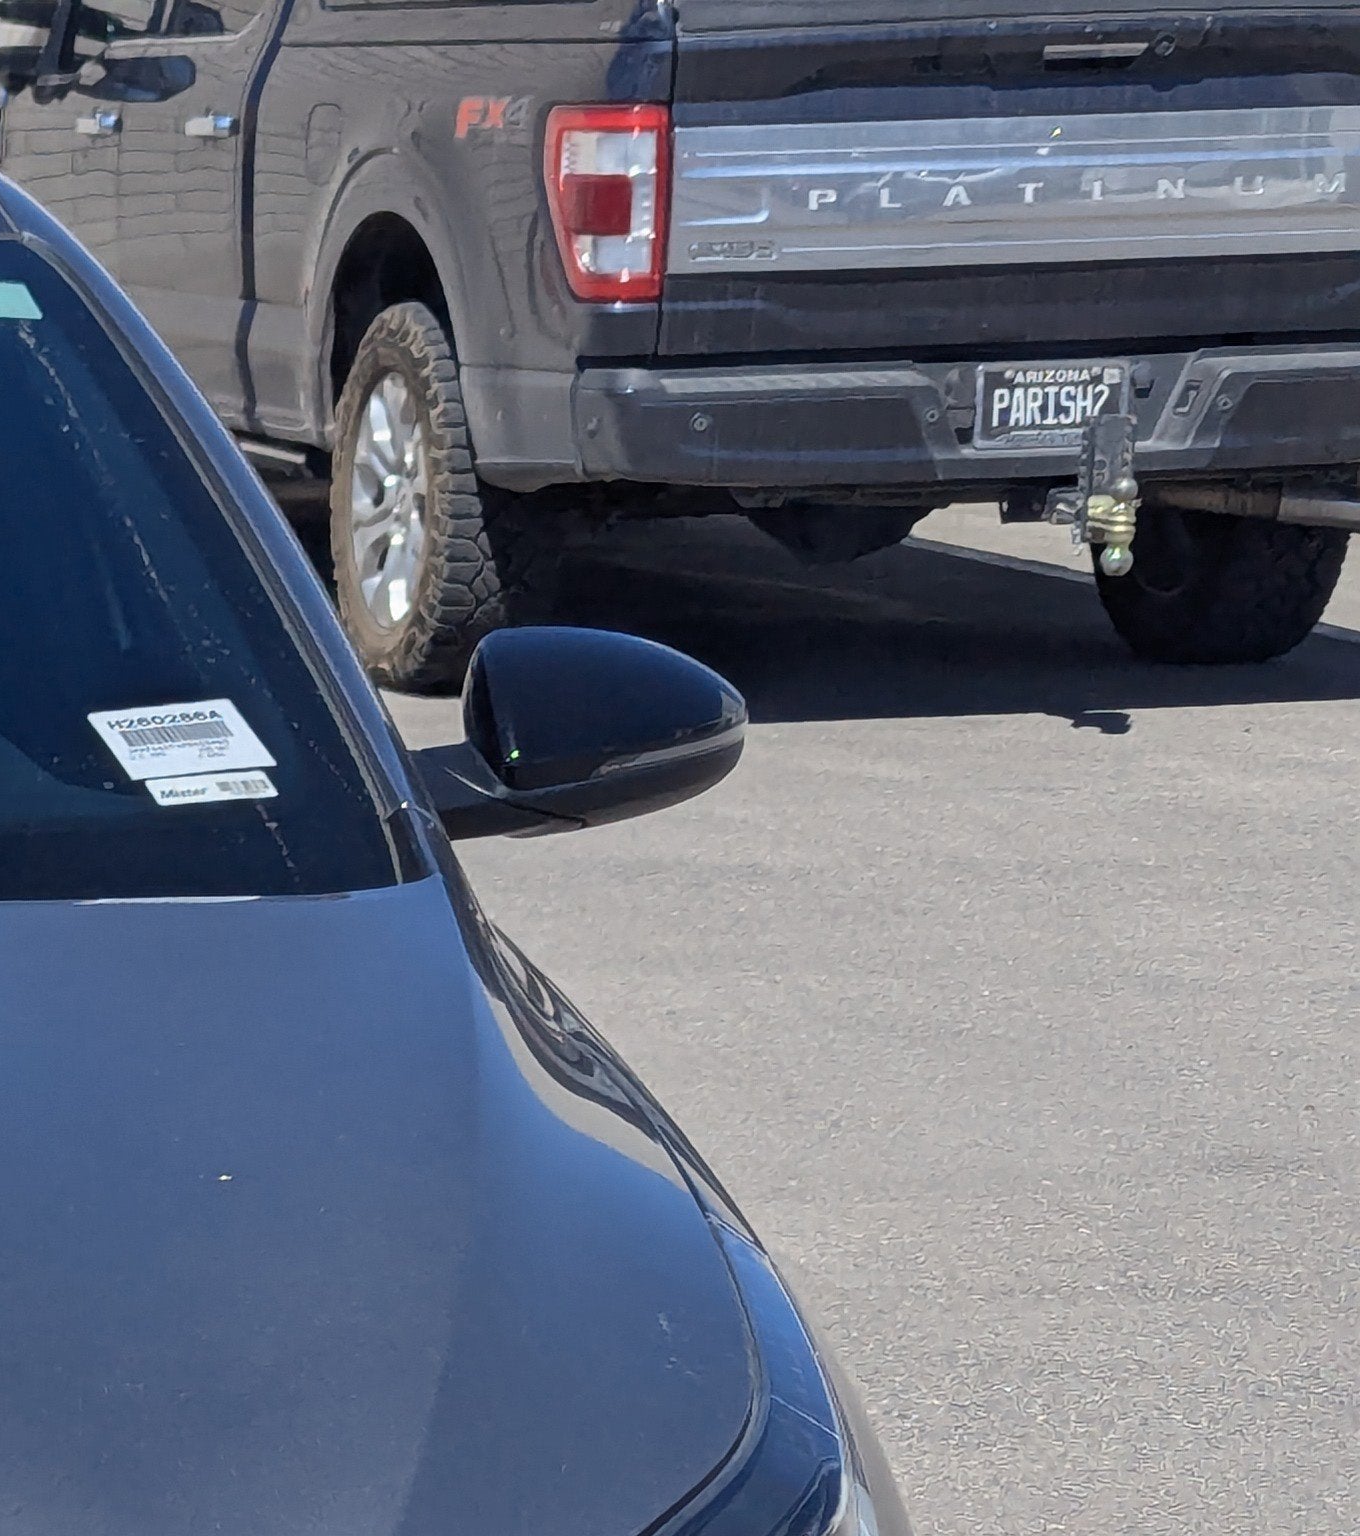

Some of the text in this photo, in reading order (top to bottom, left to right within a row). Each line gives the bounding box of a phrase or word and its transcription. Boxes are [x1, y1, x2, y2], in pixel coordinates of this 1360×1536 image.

[454, 95, 536, 139] FX4
[808, 171, 1347, 211] PLATINUM
[1013, 368, 1091, 384] ARIZONA
